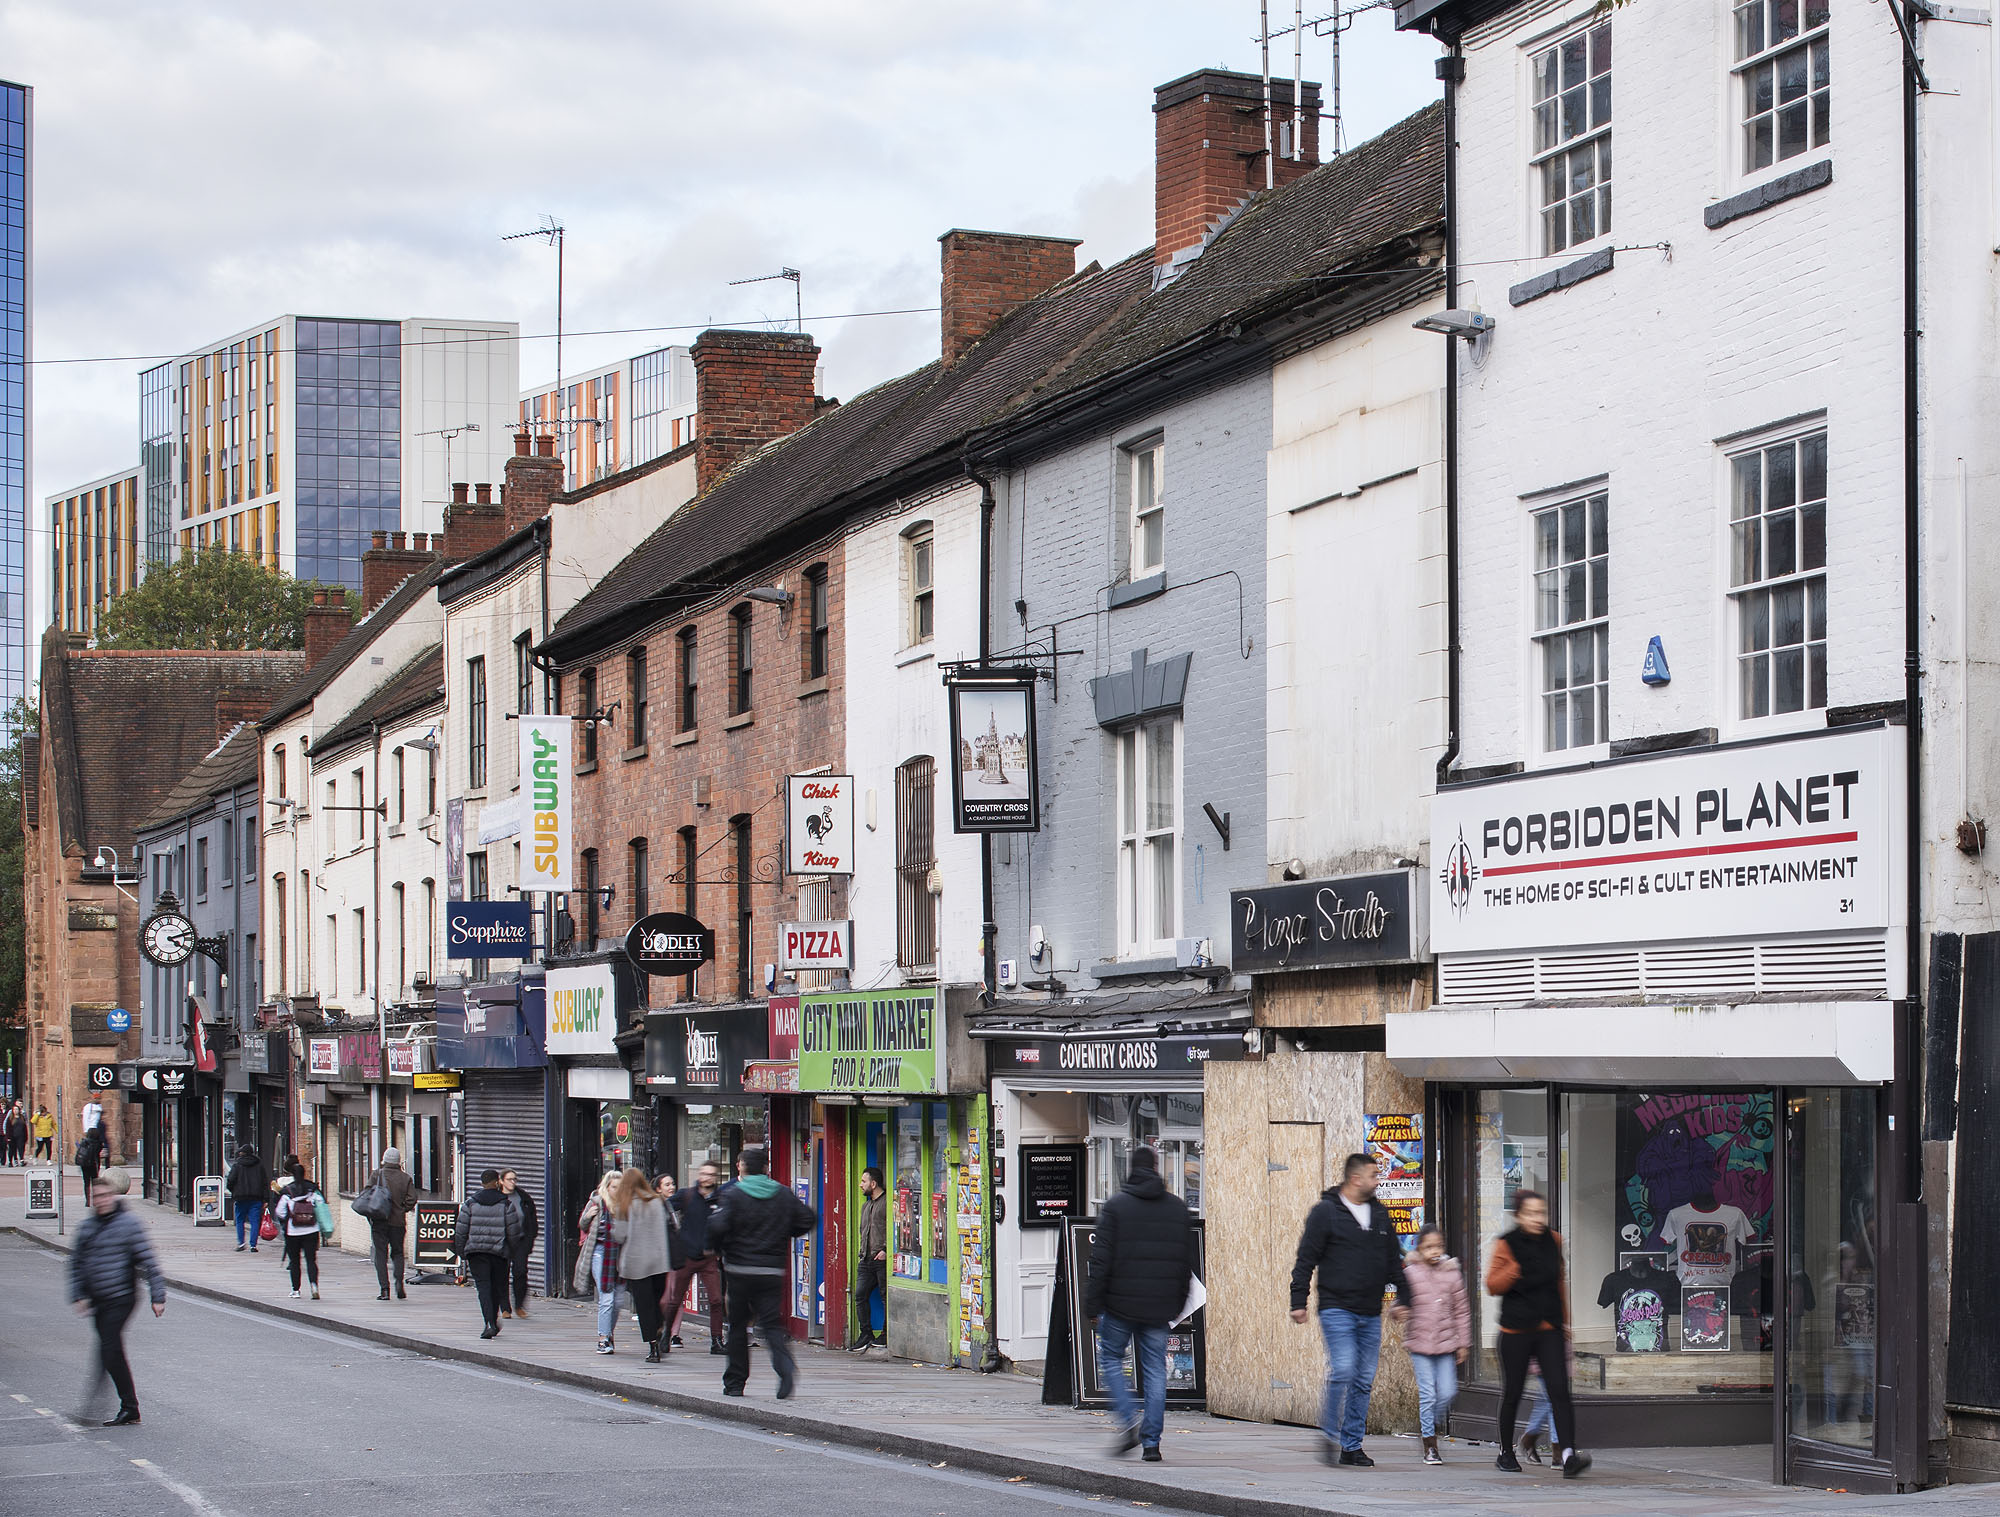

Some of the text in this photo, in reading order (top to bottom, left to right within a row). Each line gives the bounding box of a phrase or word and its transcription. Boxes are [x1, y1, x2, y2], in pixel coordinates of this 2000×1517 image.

[801, 783, 840, 800] Chick
[530, 728, 560, 879] SUBWAY
[965, 803, 1029, 813] COVENTRY CROSS
[1484, 770, 1859, 858] FORBIDDEN PLANET
[803, 850, 840, 869] King
[1484, 856, 1858, 907] THE HOME OF SCI-FI & CULT ENTERTAINMENT
[1839, 899, 1854, 913] 31
[451, 916, 527, 944] Sapphire
[787, 931, 843, 959] PIZZA
[552, 986, 604, 1034] SUBWAY
[803, 997, 935, 1053] CITY MINI MARKET
[1060, 1042, 1158, 1069] COVENTRY CROSS
[1197, 1049, 1210, 1060] Sport
[830, 1056, 857, 1088] FOOD
[858, 1056, 866, 1088] &
[868, 1056, 902, 1088] DRINK
[1377, 1116, 1411, 1126] CIRCUS
[1684, 1105, 1742, 1138] KIDS
[1367, 1126, 1421, 1141] FANTASIA
[420, 1214, 455, 1224] VAPE
[1388, 1209, 1411, 1219] RCUS
[419, 1228, 455, 1239] SHOP
